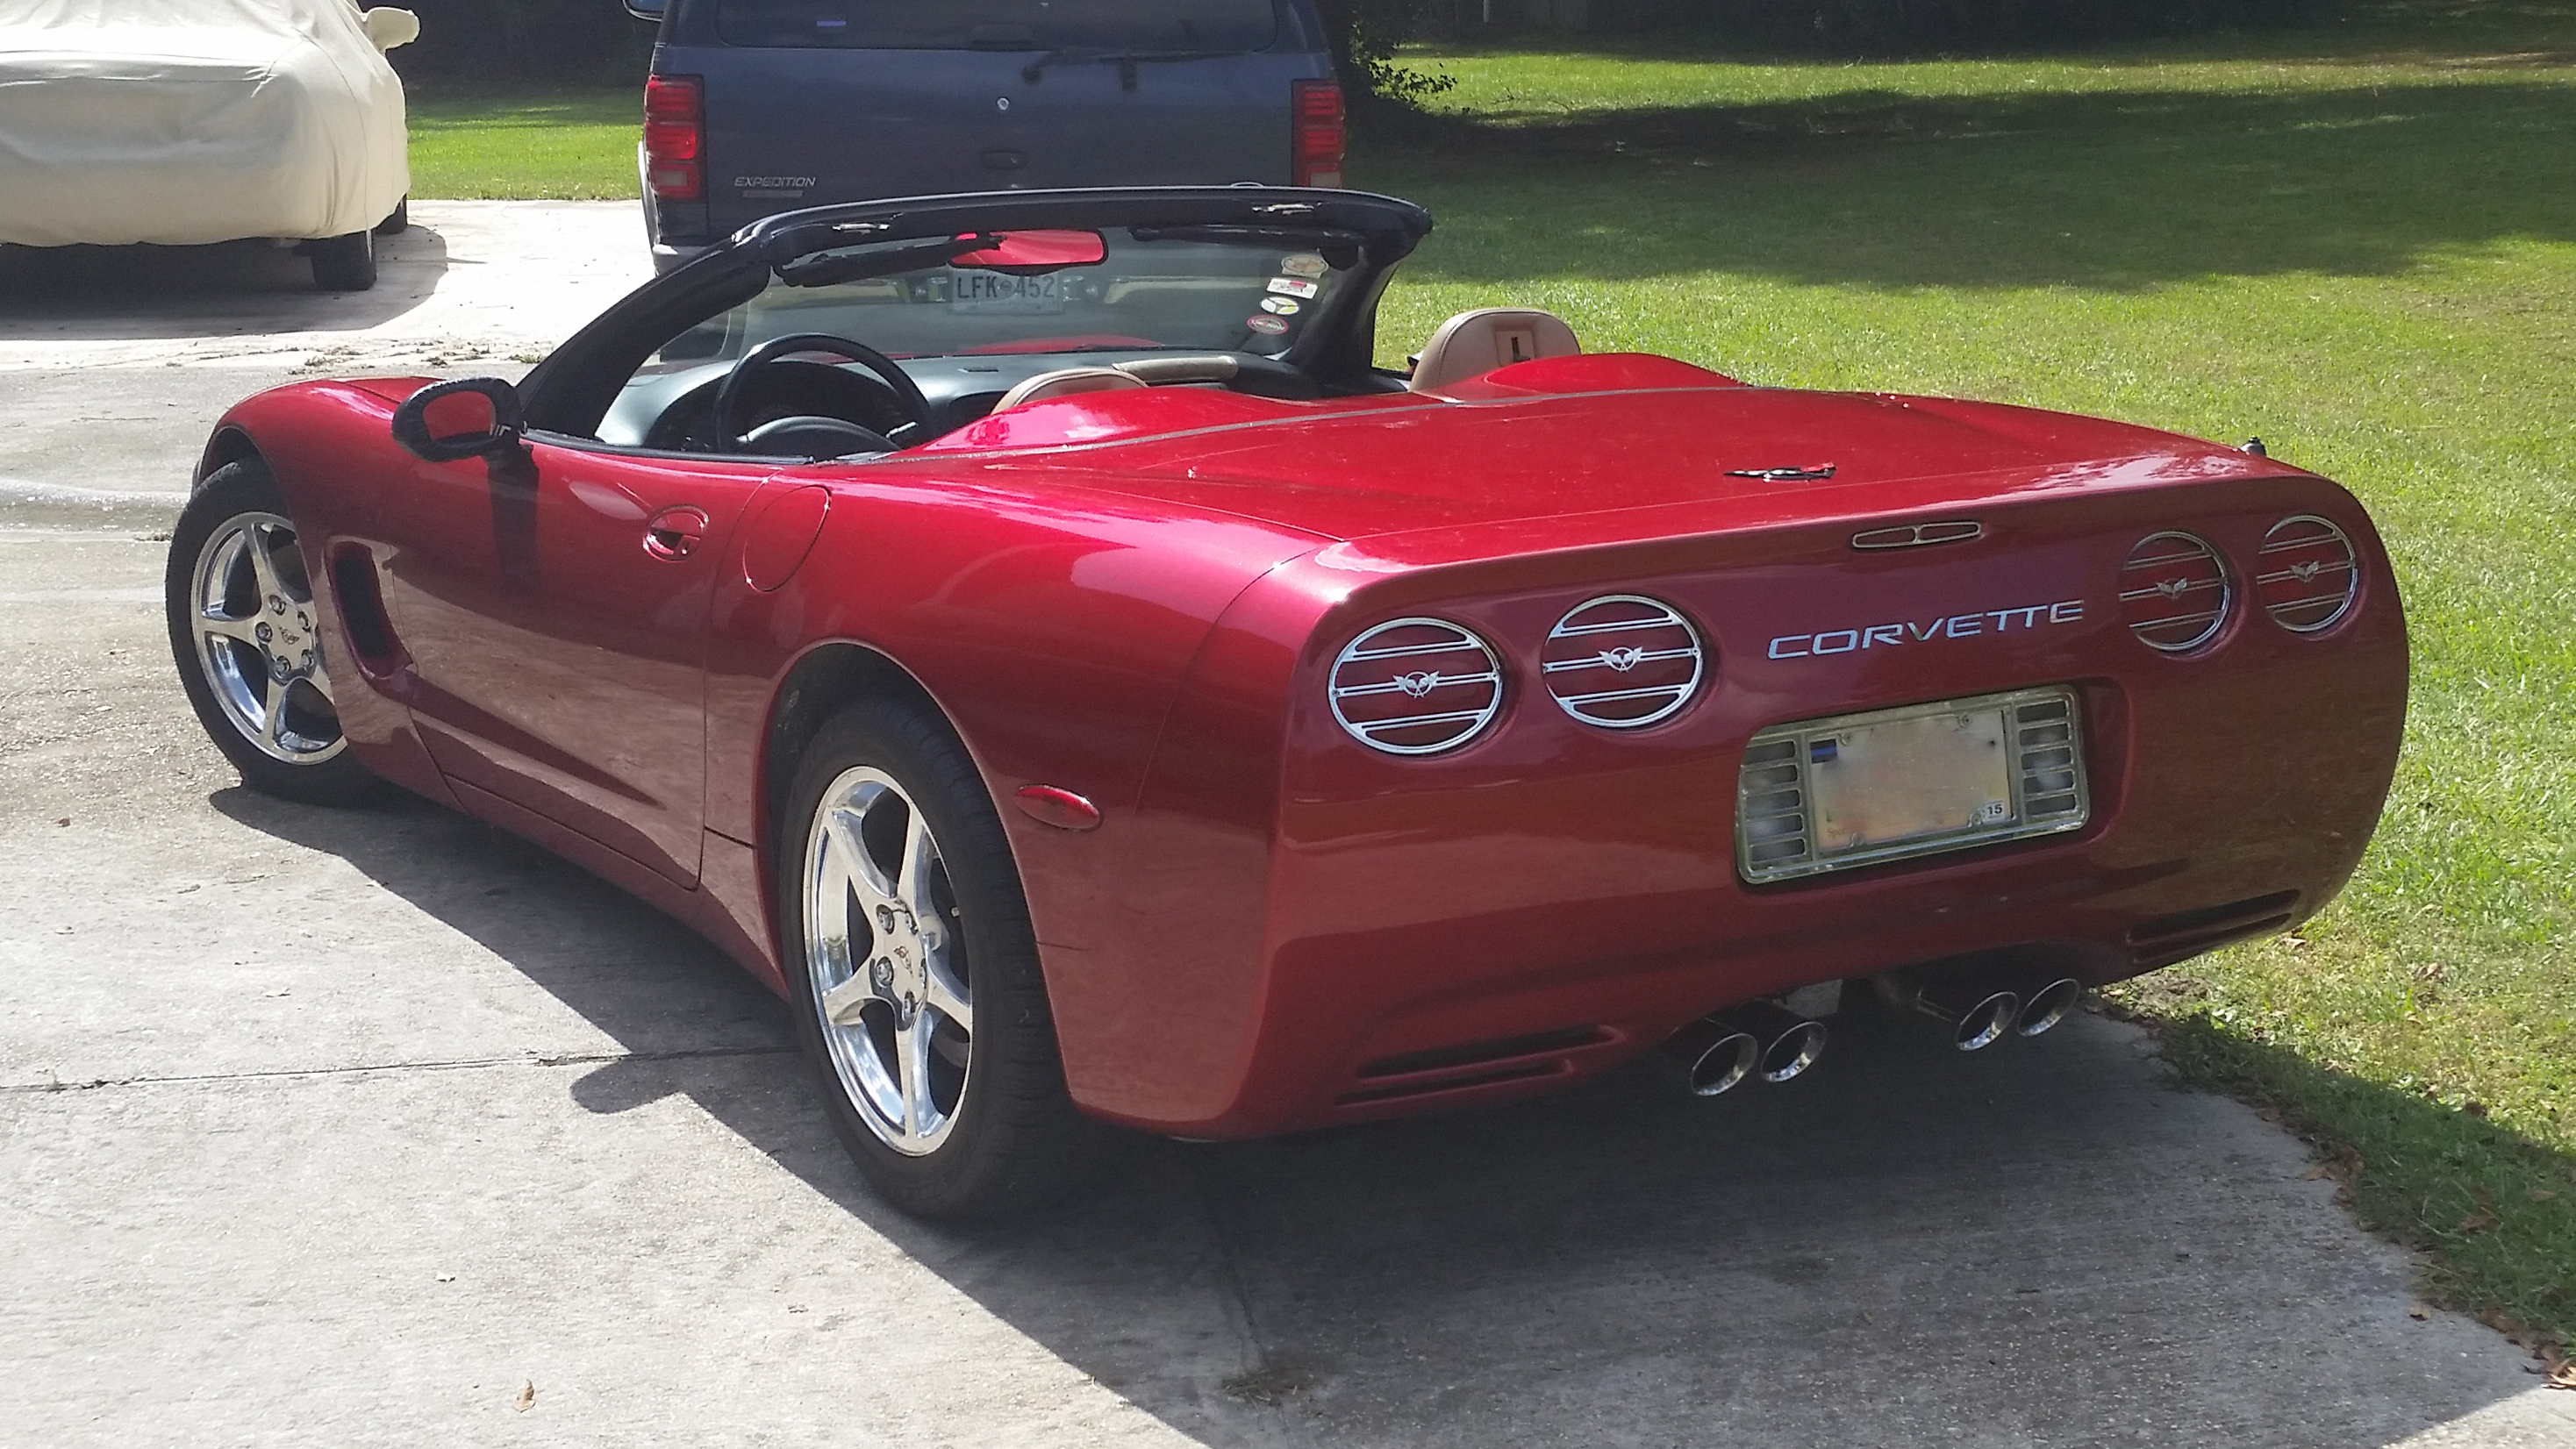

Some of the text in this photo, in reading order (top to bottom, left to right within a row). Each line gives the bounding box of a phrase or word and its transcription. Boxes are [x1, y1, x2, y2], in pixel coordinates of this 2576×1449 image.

[734, 176, 817, 187] EXPEDITION
[957, 275, 1055, 299] LFK 452
[1767, 599, 2086, 660] CORVETTE
[1987, 803, 2003, 815] 15
